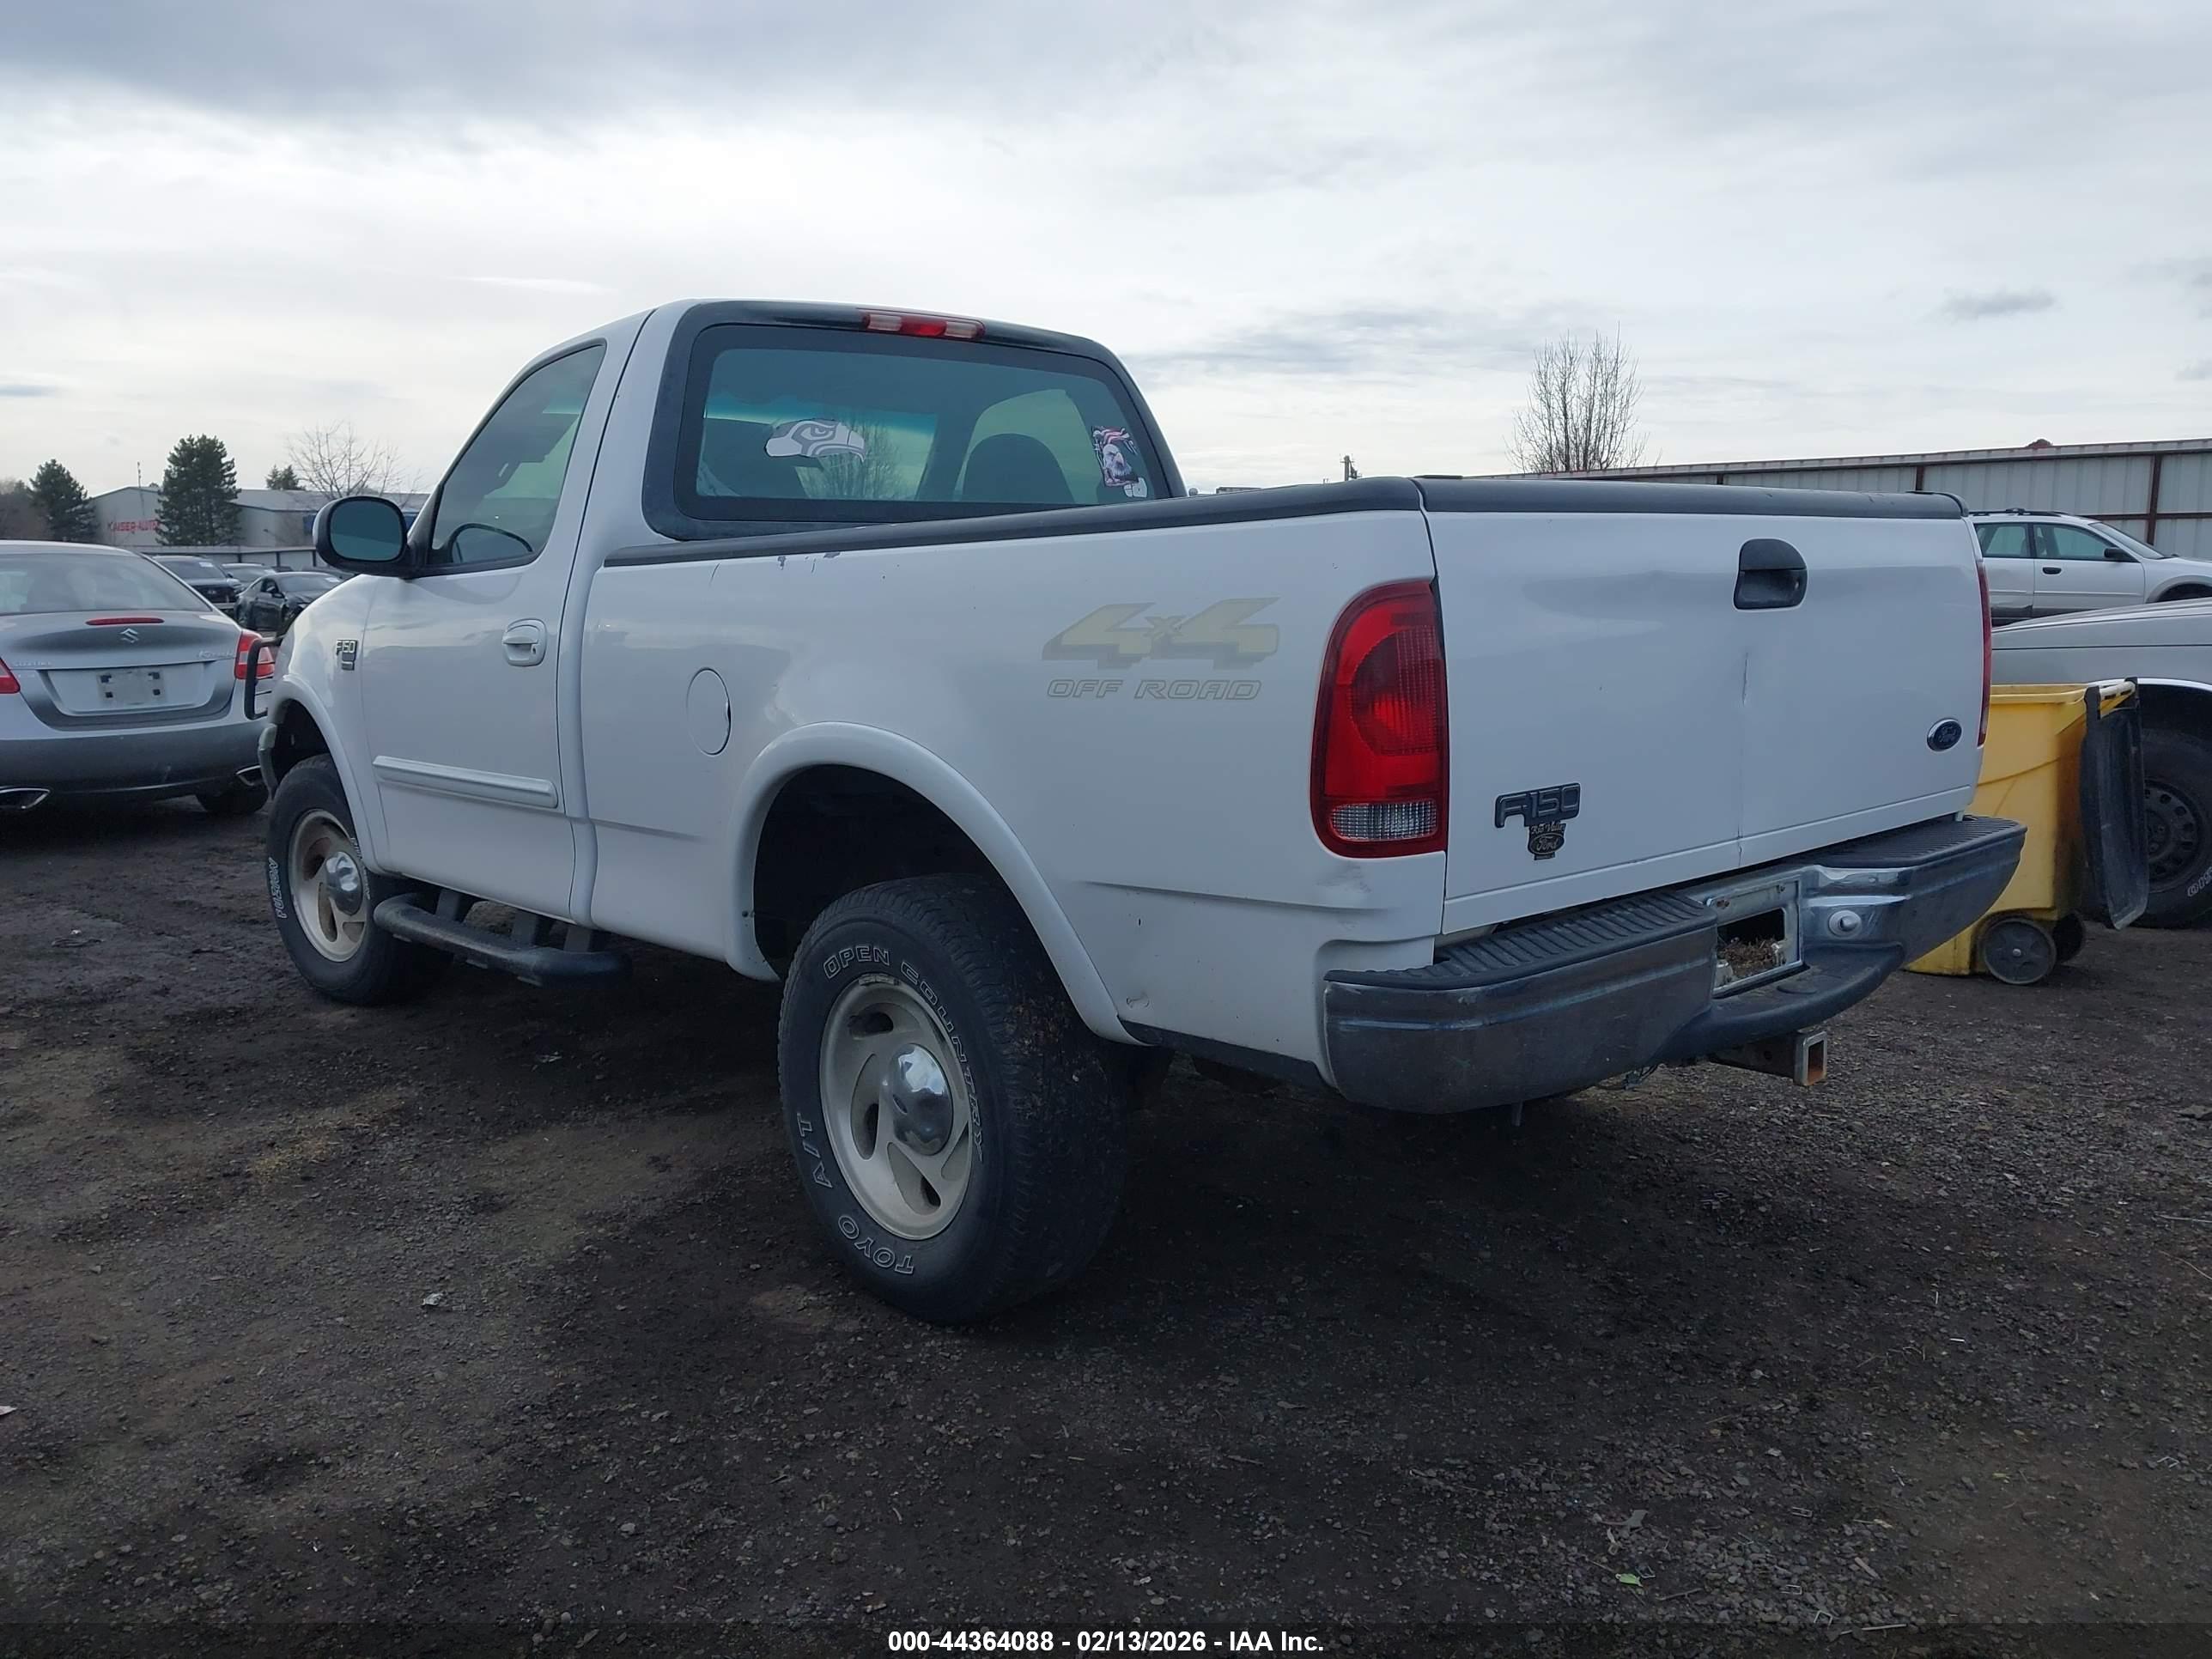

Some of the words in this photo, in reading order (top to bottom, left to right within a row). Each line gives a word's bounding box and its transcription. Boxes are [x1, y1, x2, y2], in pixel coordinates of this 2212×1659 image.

[1046, 679, 1124, 699] OFF
[1133, 679, 1261, 701] ROAD
[823, 945, 890, 980] OPEN
[900, 961, 983, 1162] COUNTRY
[796, 1112, 833, 1188] A/T
[837, 1214, 915, 1275] TOYO
